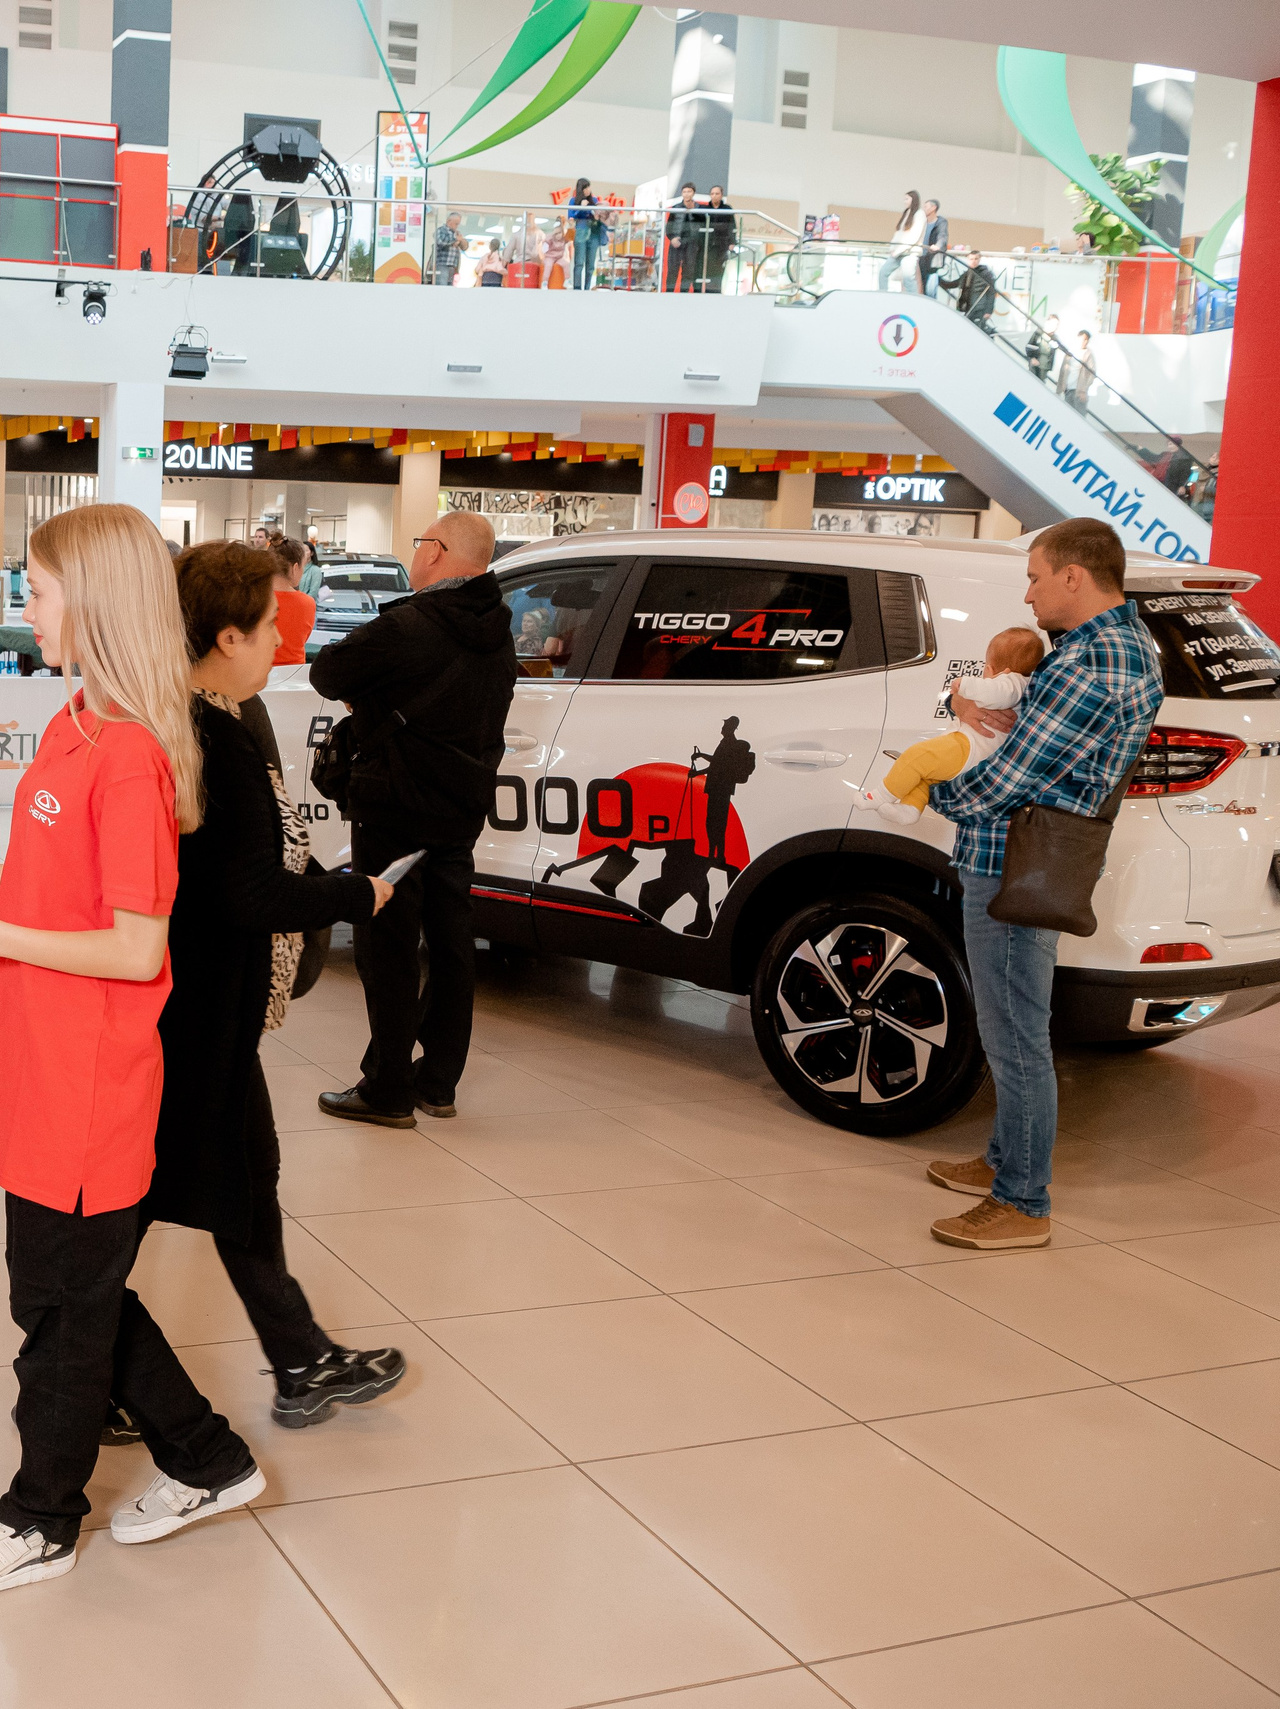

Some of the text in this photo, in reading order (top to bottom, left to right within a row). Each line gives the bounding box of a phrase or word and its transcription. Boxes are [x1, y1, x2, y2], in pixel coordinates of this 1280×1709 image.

[887, 368, 917, 378] этаж
[164, 444, 253, 471] 20LINE
[876, 476, 946, 502] OPTIK
[1050, 432, 1209, 566] ЧИТАЙ-ГОР
[1143, 595, 1188, 613] CHERY
[633, 613, 844, 647] TIGGO 4 PRO
[660, 634, 712, 645] CHERY
